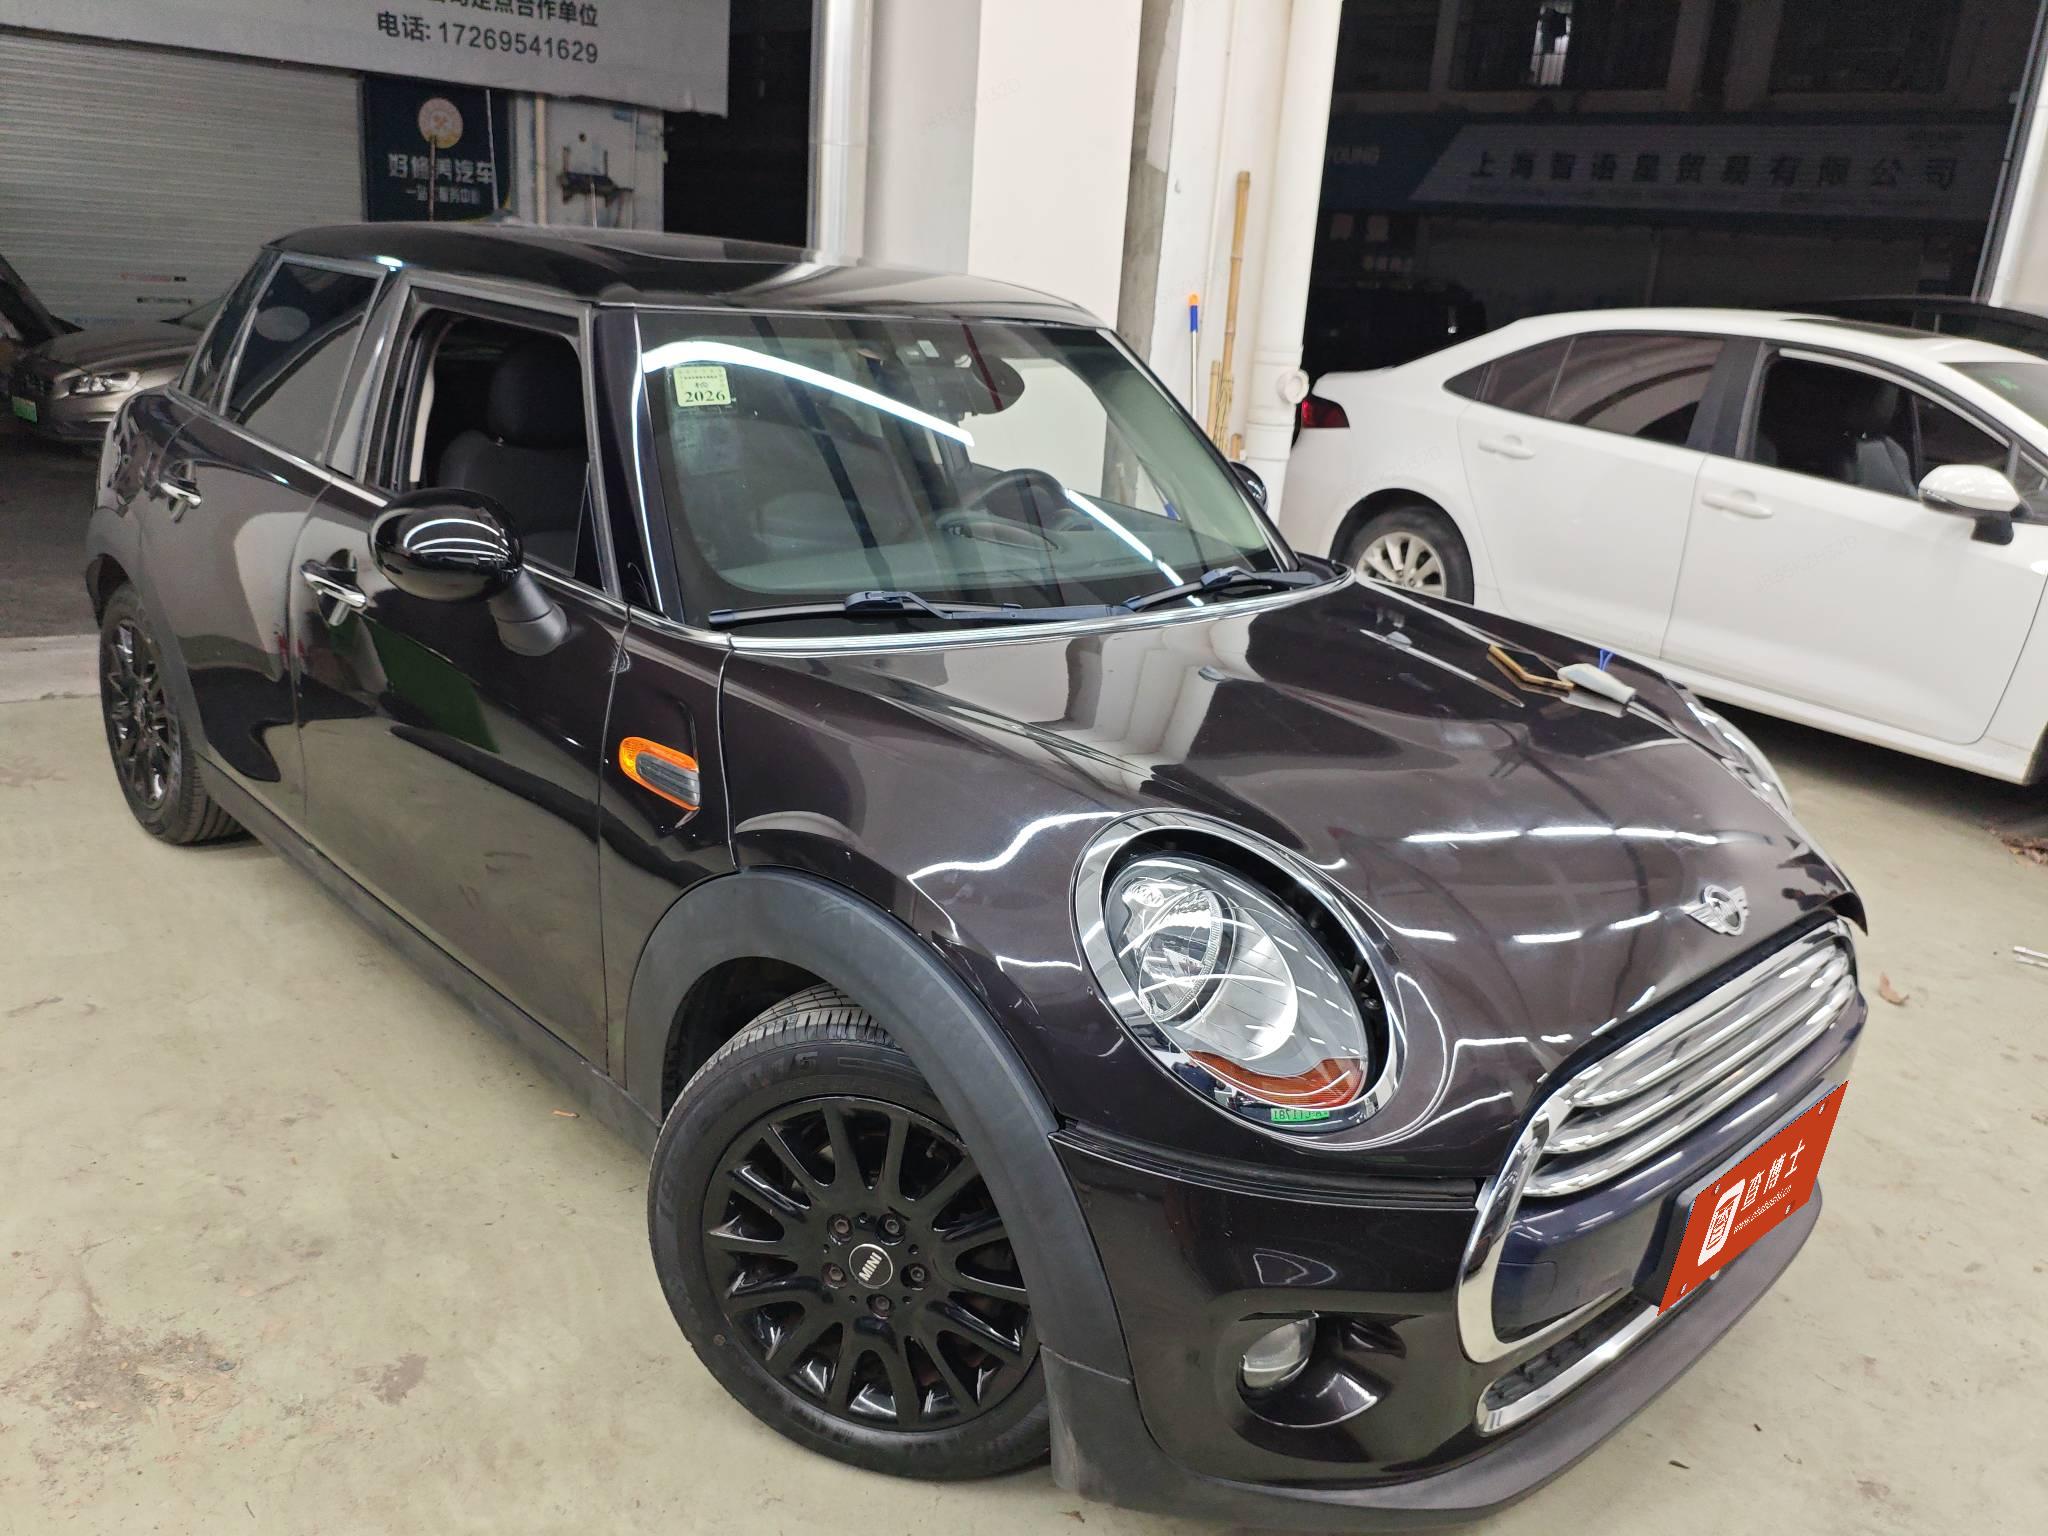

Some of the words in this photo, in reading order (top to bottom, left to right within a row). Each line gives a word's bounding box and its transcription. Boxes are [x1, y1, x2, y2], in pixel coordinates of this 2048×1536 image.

[439, 22, 598, 64] 17269541629
[685, 391, 726, 402] 2026
[859, 1251, 882, 1281] MINI
